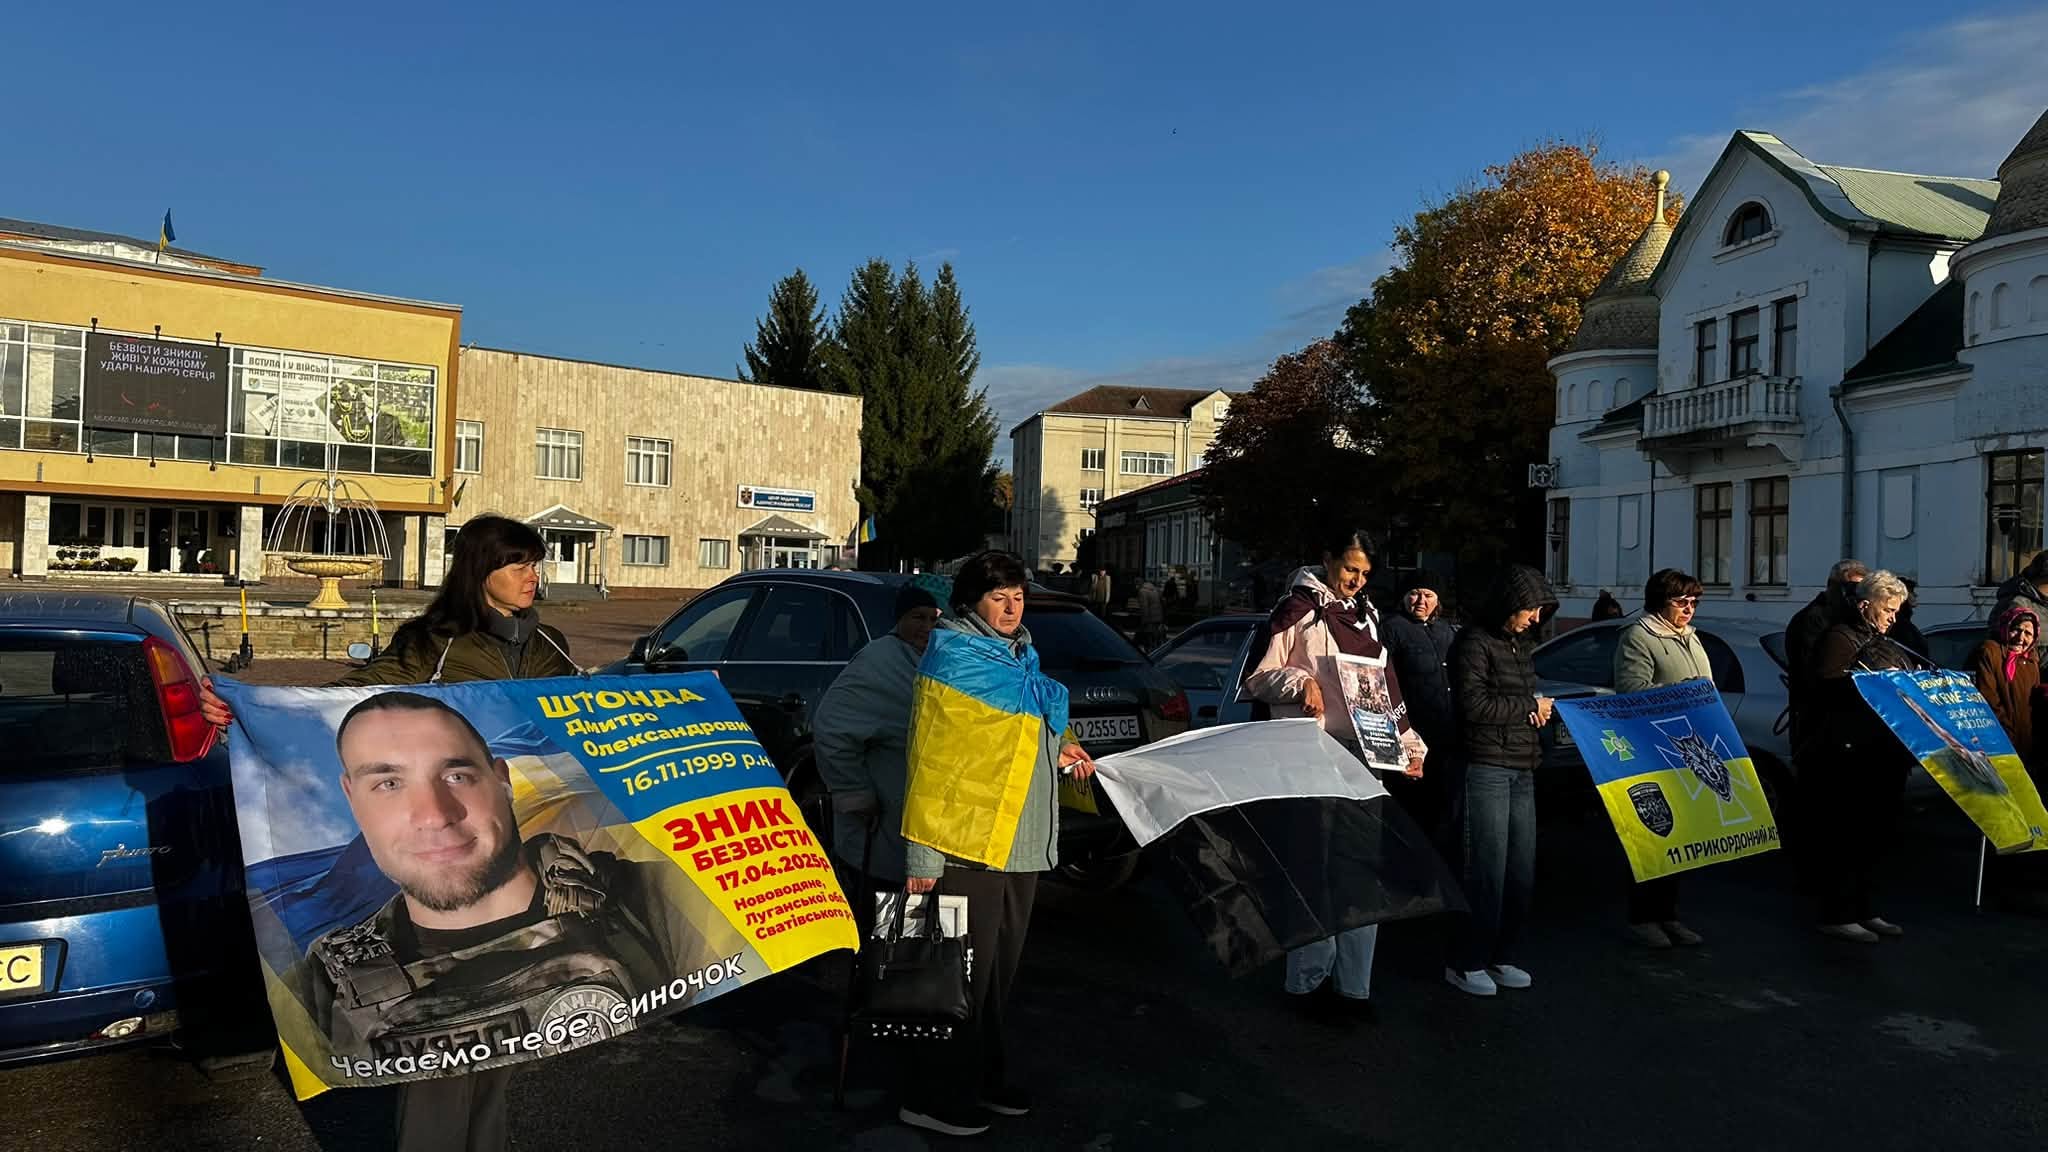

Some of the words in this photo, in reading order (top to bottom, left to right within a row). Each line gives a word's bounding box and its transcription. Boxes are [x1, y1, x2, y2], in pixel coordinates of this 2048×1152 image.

[110, 341, 160, 355] БЕЗВІСТИ
[163, 347, 201, 360] ЗНИКЛІ
[111, 351, 140, 363] ЖИВІ
[143, 355, 150, 364] У
[152, 356, 206, 370] КОЖНОМУ
[100, 360, 132, 372] УДАРІ
[135, 364, 180, 377] НАШОГО
[182, 369, 216, 381] СЕРЦЯ
[537, 688, 707, 718] ШТОНДА
[565, 711, 659, 736] Дмитро
[583, 721, 753, 757] Олександрови
[1086, 719, 1117, 738] 2555
[1119, 718, 1137, 737] CE
[622, 751, 738, 797] 16.11.1999
[664, 798, 793, 851] ЗНИК
[691, 829, 814, 872] БЕЗВІСТИ
[1667, 847, 1682, 864] 11
[1685, 824, 1768, 861] ПРИКОРДОННИЙ
[734, 879, 827, 911] Нововодяне,
[745, 892, 827, 926] Луганської
[755, 909, 844, 941] Сватівського
[331, 1043, 491, 1079] Чекаємо
[502, 1015, 599, 1057] тебе,
[609, 953, 746, 1025] синочок
